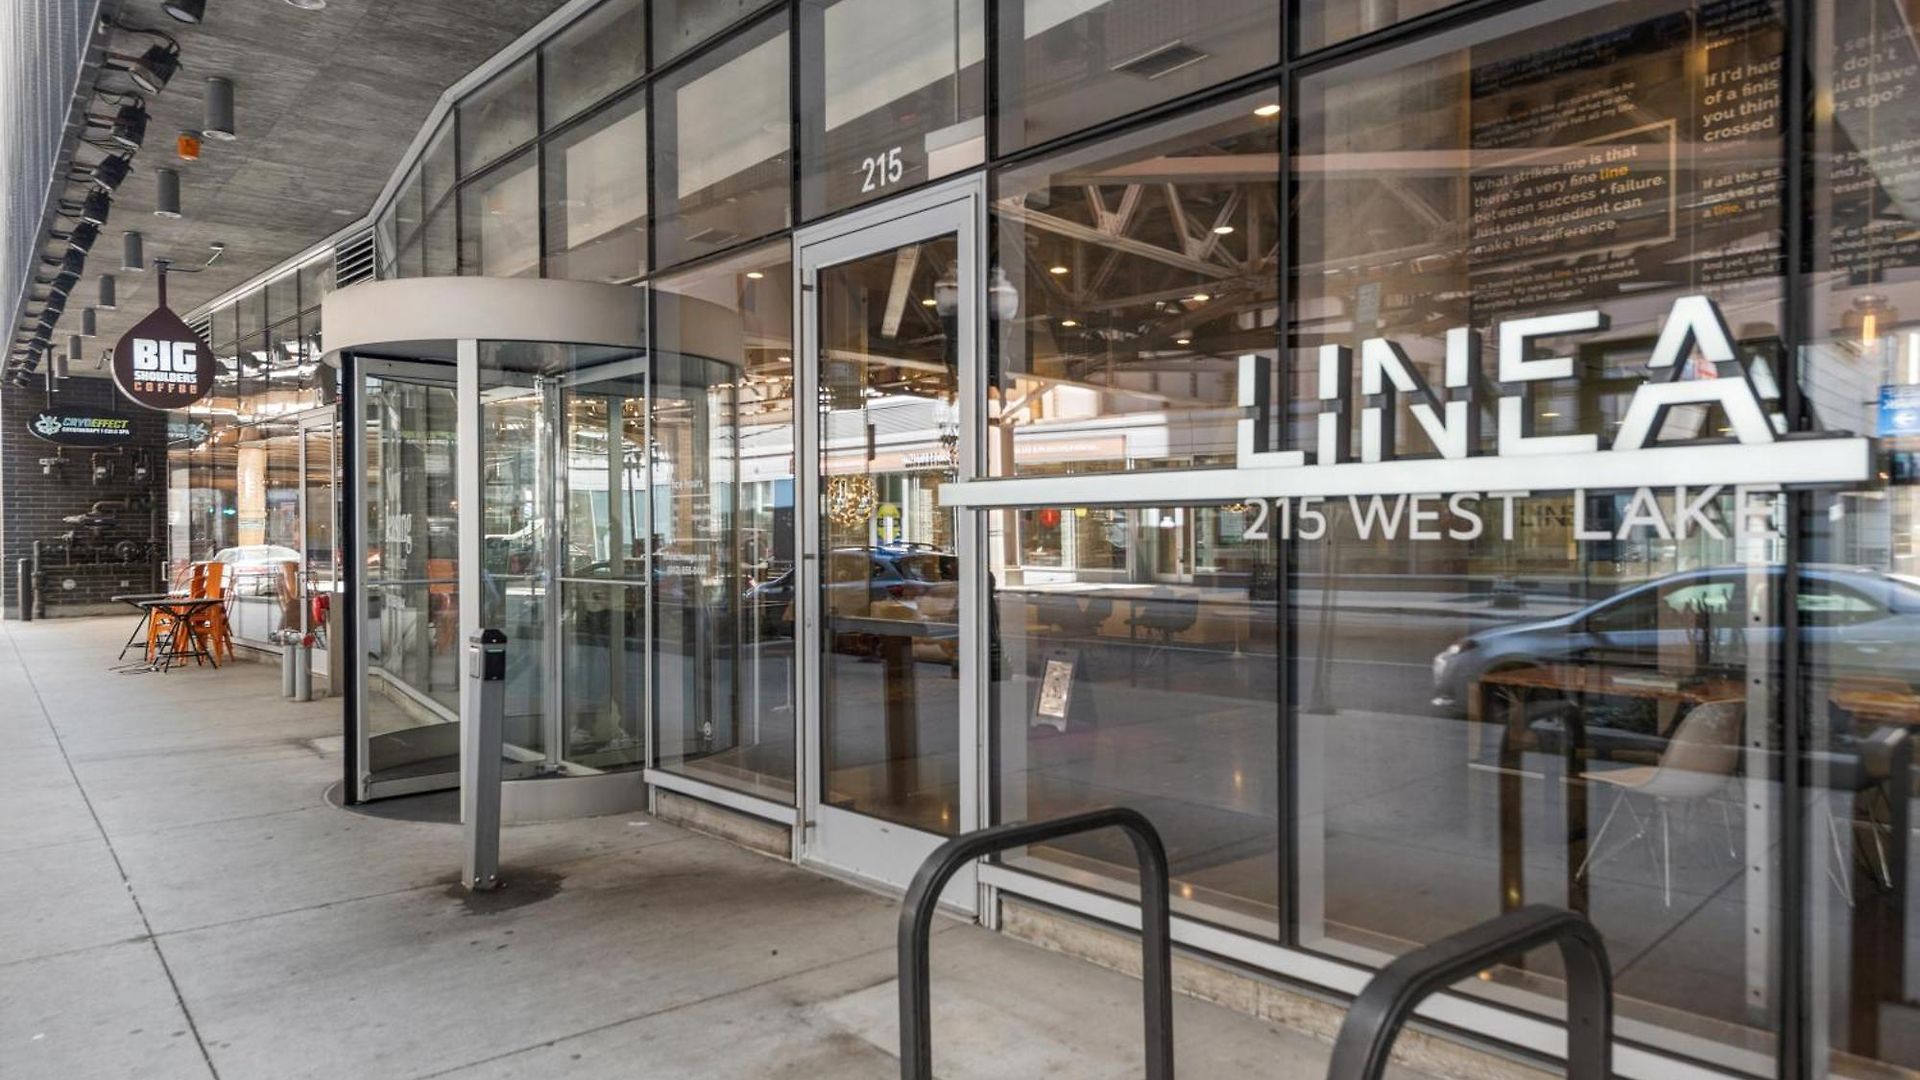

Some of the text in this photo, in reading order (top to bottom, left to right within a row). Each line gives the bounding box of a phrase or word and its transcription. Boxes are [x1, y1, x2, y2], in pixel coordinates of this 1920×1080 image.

[1705, 57, 1781, 87] If I'd had
[1844, 49, 1898, 71] don't
[1867, 64, 1917, 86] have
[1704, 78, 1779, 105] of a finis
[1855, 84, 1904, 110] ago?
[1703, 108, 1735, 127] you
[1704, 115, 1774, 142] crossed
[861, 146, 903, 193] 215
[1473, 144, 1638, 192] What strikes me is that
[1702, 179, 1713, 189] If
[1715, 175, 1734, 187] all
[1735, 171, 1759, 183] the
[1474, 164, 1629, 208] there's a very fine line
[1474, 202, 1534, 223] between
[1537, 190, 1596, 210] success
[1504, 221, 1531, 235] one
[1533, 202, 1609, 229] ingredient
[1613, 196, 1642, 210] can
[1474, 240, 1512, 255] make
[1514, 231, 1537, 247] the
[132, 338, 198, 373] BIG
[133, 370, 198, 384] SHOULDERS
[133, 382, 198, 395] COFFEE
[1237, 295, 1777, 470] LINEA
[62, 417, 129, 430] CRYOEFFECT
[1243, 484, 1784, 542] 215 WEST LAKE
